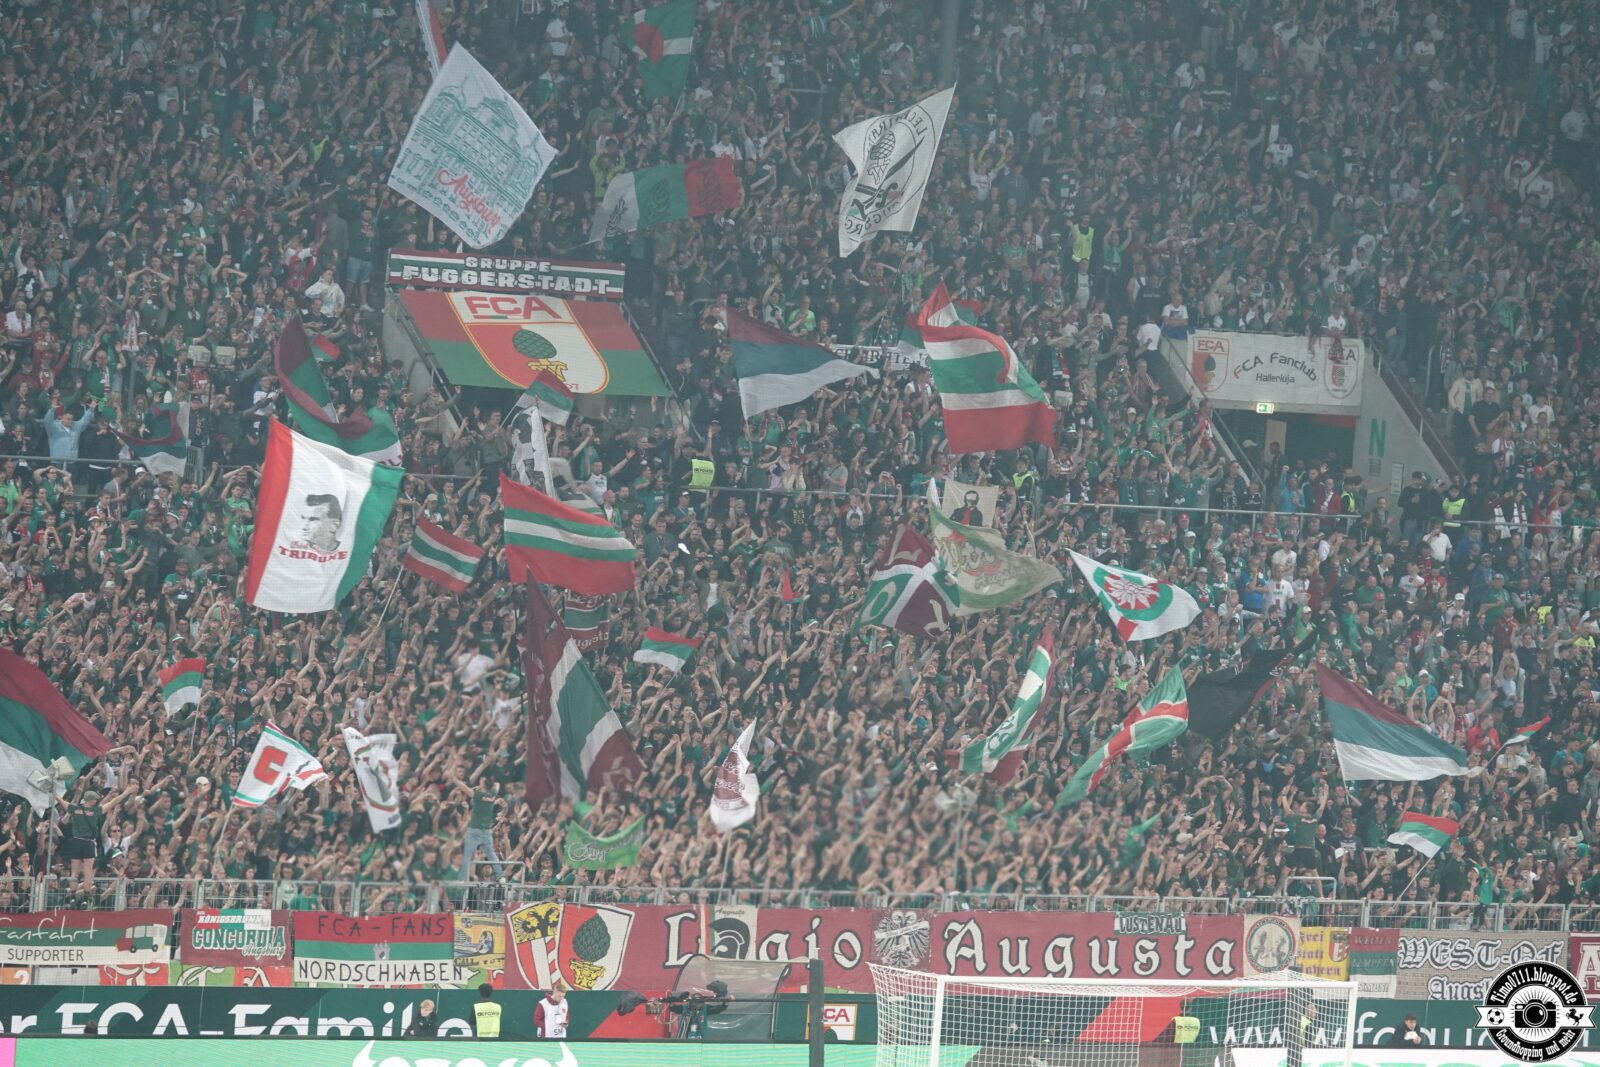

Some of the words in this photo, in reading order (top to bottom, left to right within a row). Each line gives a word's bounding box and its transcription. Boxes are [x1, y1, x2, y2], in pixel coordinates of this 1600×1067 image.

[465, 256, 551, 272] GRUPPE
[402, 265, 610, 294] FUGGERSTADT
[464, 296, 562, 320] FCA
[1197, 340, 1225, 352] FCA
[1233, 355, 1264, 379] FCA
[1270, 352, 1317, 381] Fanclub
[1369, 418, 1386, 458] N
[1119, 914, 1184, 934] LUSTENAU
[8, 948, 84, 961] SUPPORTER
[664, 911, 863, 978] Lgio
[944, 918, 1236, 979] Augusta
[299, 960, 462, 982] NORDSCHWABEN
[823, 1008, 851, 1023] CA
